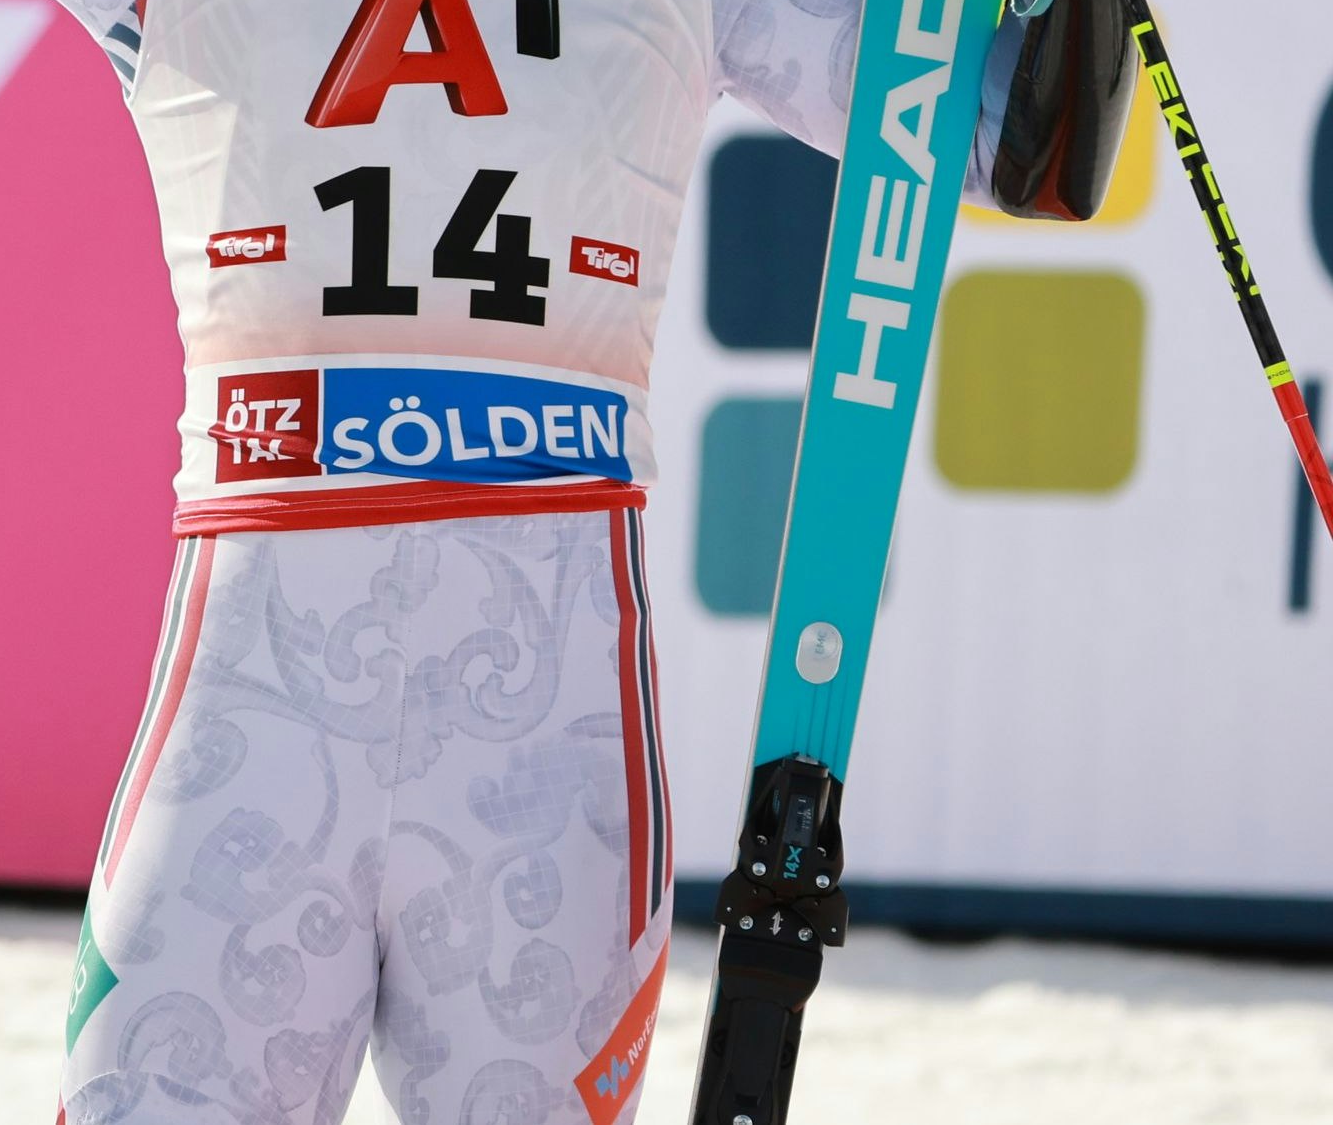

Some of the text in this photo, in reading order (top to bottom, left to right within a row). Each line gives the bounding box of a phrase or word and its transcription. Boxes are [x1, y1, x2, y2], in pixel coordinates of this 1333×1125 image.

[1131, 20, 1201, 159] LEKI
[212, 233, 275, 261] Tirol
[313, 166, 550, 327] 14
[581, 246, 636, 279] Tirol
[224, 387, 301, 434] ÖTZ
[333, 396, 621, 470] SÖLDEN
[783, 844, 803, 879] 14X
